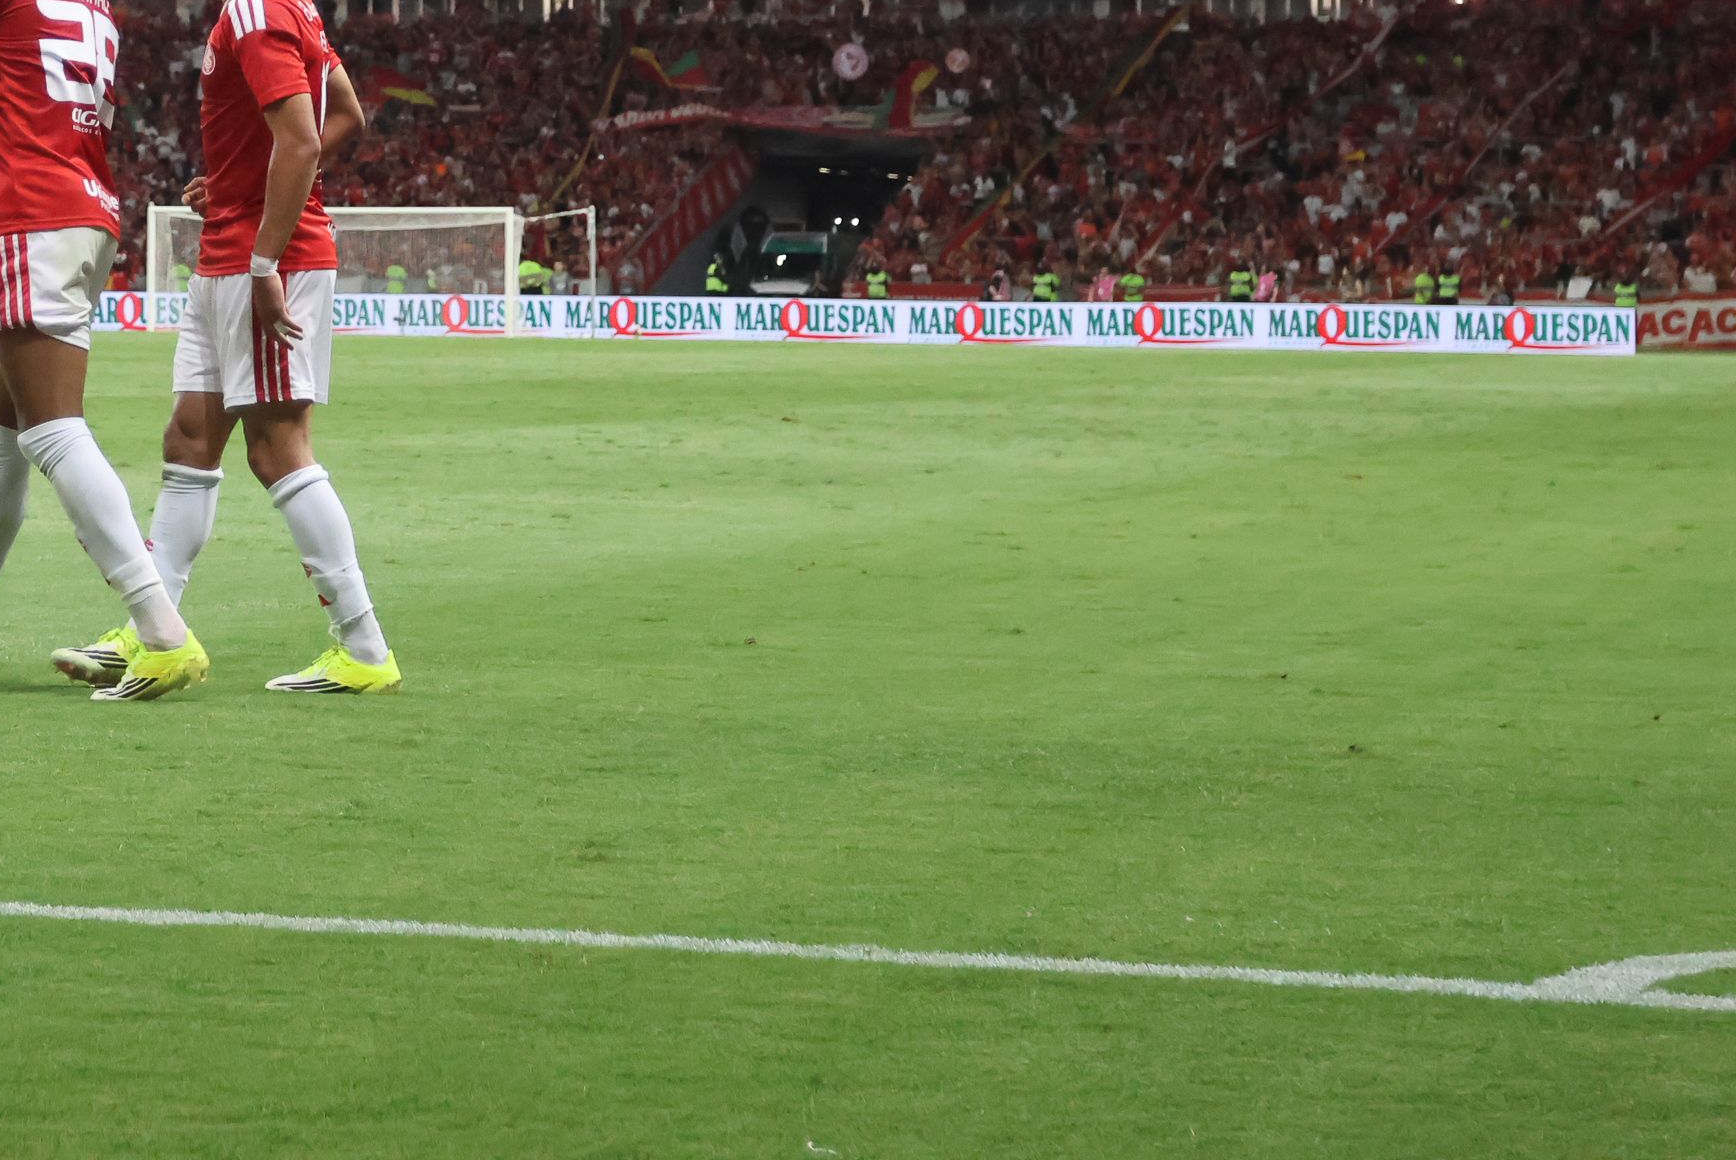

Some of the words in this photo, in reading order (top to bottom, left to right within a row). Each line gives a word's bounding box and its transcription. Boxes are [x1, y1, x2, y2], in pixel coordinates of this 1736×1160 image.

[398, 294, 552, 331] MARQUESAN
[565, 297, 722, 335] MARQUESPAN
[735, 298, 896, 337] MARQUESPAN
[909, 302, 1073, 340] MARQUESPAN
[1086, 303, 1255, 341] MARQUESPAN
[1268, 304, 1441, 345] MARQUESPAN
[1455, 307, 1630, 347] MARQUESPAN
